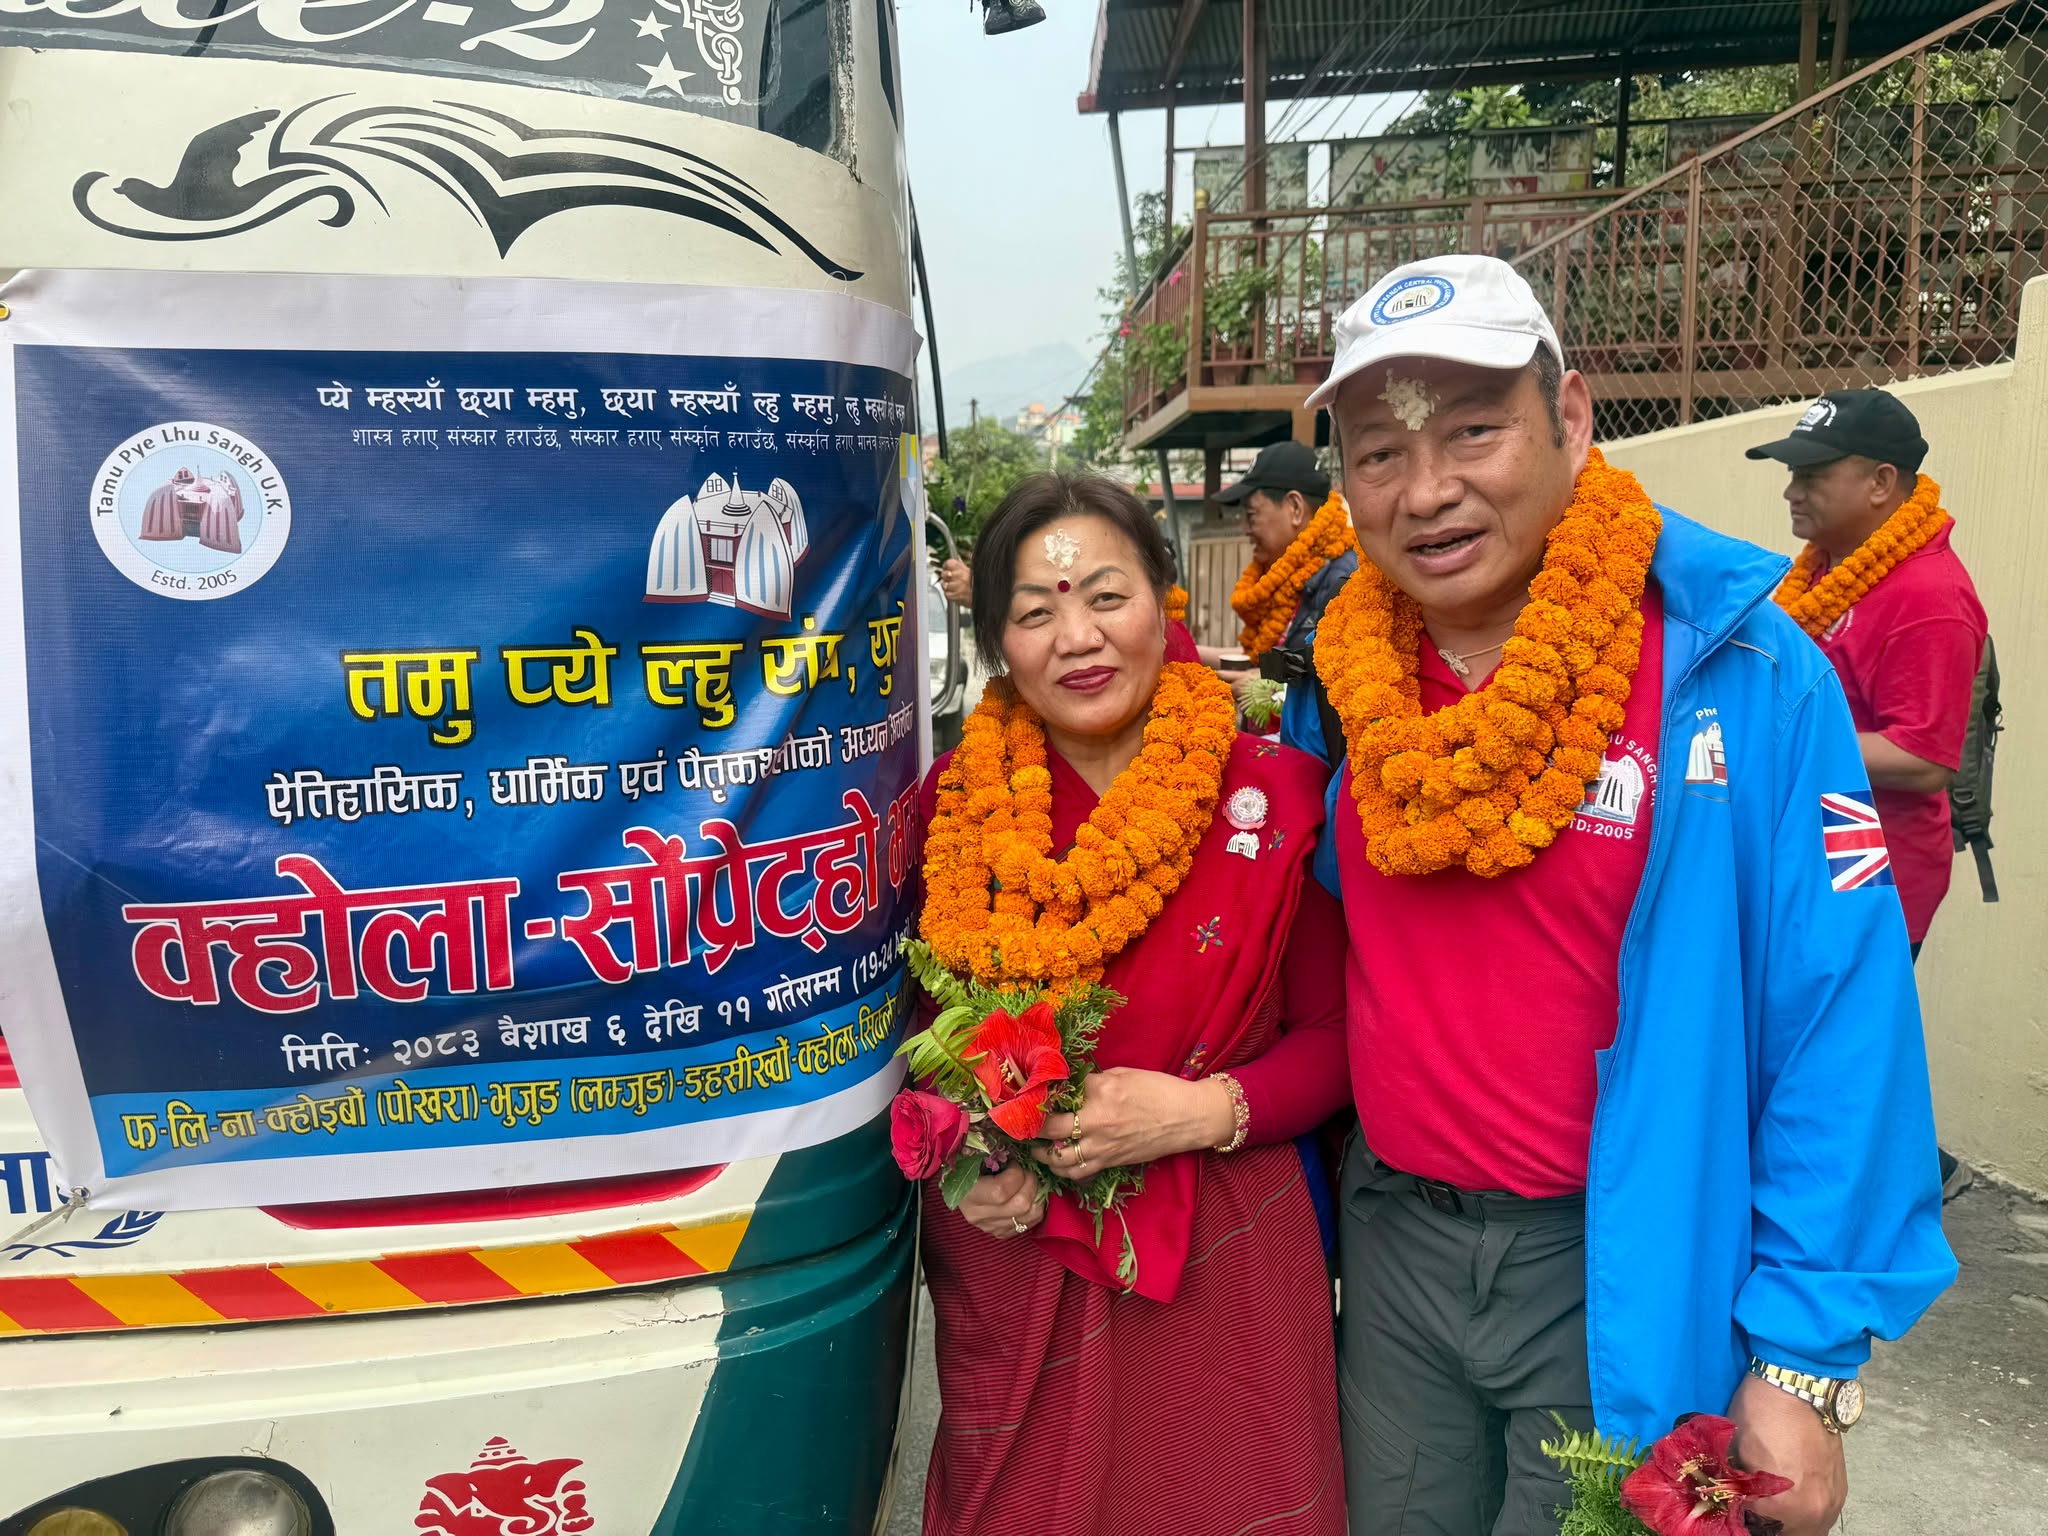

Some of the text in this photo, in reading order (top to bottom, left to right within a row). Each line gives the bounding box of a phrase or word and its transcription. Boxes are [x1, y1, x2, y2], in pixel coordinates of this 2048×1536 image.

[526, 388, 586, 419] म्हमु,
[752, 392, 780, 423] ल्हु
[791, 393, 839, 425] म्हमु,
[352, 428, 393, 446] शास्त्र
[401, 429, 439, 450] हराए
[446, 426, 498, 447] संस्कार
[569, 426, 619, 447] संस्कार
[627, 430, 662, 450] हराए
[97, 426, 284, 517] Tamu Pye Lhu Sangh U.K.
[151, 569, 238, 590] Estd. 2005
[342, 650, 479, 746] तमु
[502, 629, 618, 706] प्ये
[641, 642, 744, 728] ल्हु
[1625, 739, 1658, 784] SANGH
[265, 765, 475, 825] ऐतिहासिक,
[489, 757, 608, 805] धार्मिक
[620, 749, 668, 801] एवं
[1569, 818, 1635, 839] TD: 2005
[392, 1028, 480, 1065] २०८३
[498, 1014, 592, 1051] बैशाख
[606, 1013, 626, 1047] ६
[643, 998, 704, 1044] देखि
[716, 995, 751, 1026] ११
[763, 965, 843, 1014] गतेसम्म
